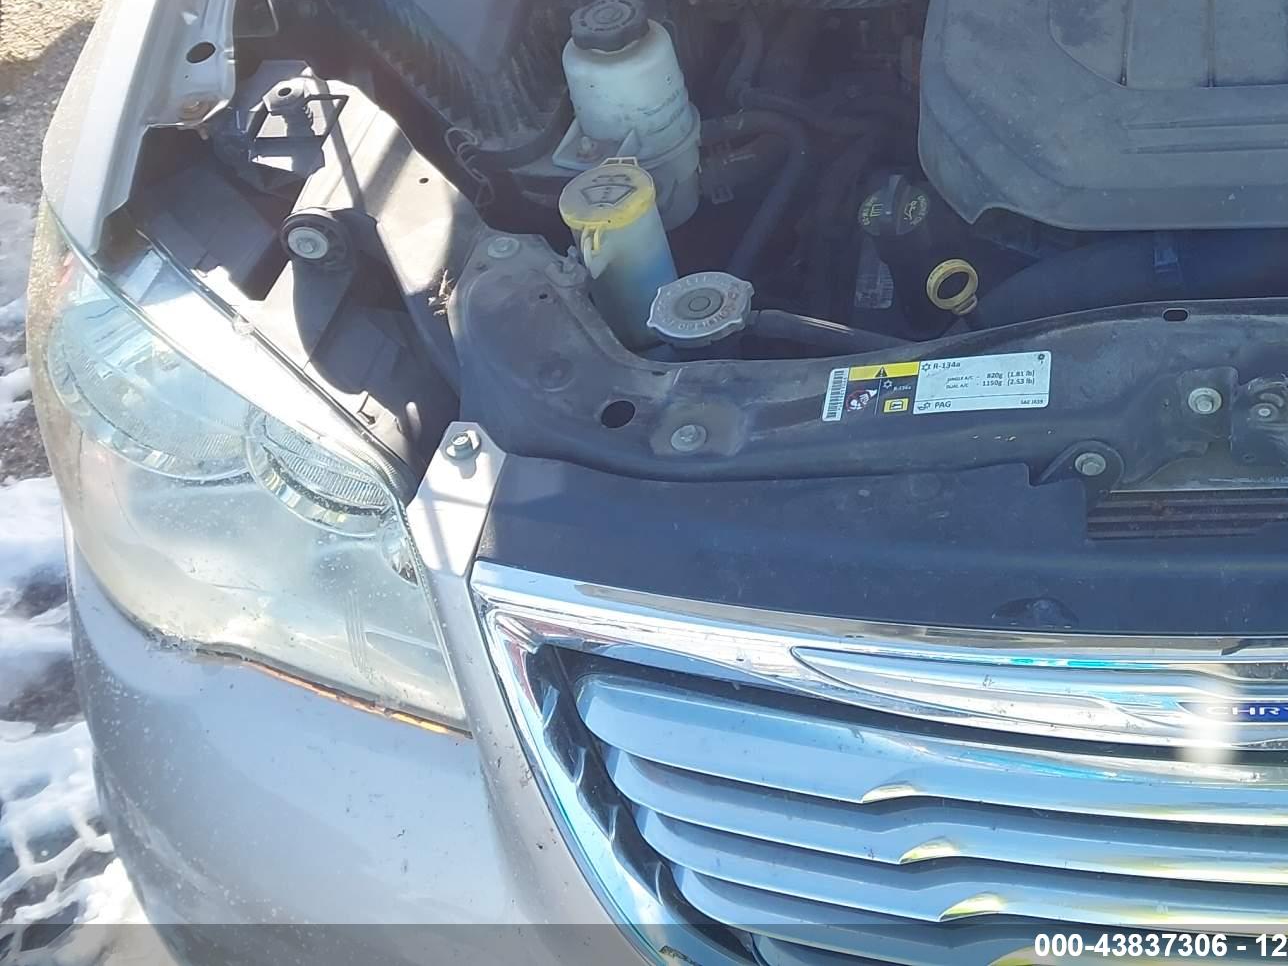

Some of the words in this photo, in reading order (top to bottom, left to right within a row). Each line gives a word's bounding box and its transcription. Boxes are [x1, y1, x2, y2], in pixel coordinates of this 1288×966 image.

[933, 361, 961, 370] R-134a
[1007, 371, 1025, 379] (1.81
[1025, 369, 1036, 377] lb)
[1025, 377, 1036, 385] lb)
[934, 401, 952, 409] PAG
